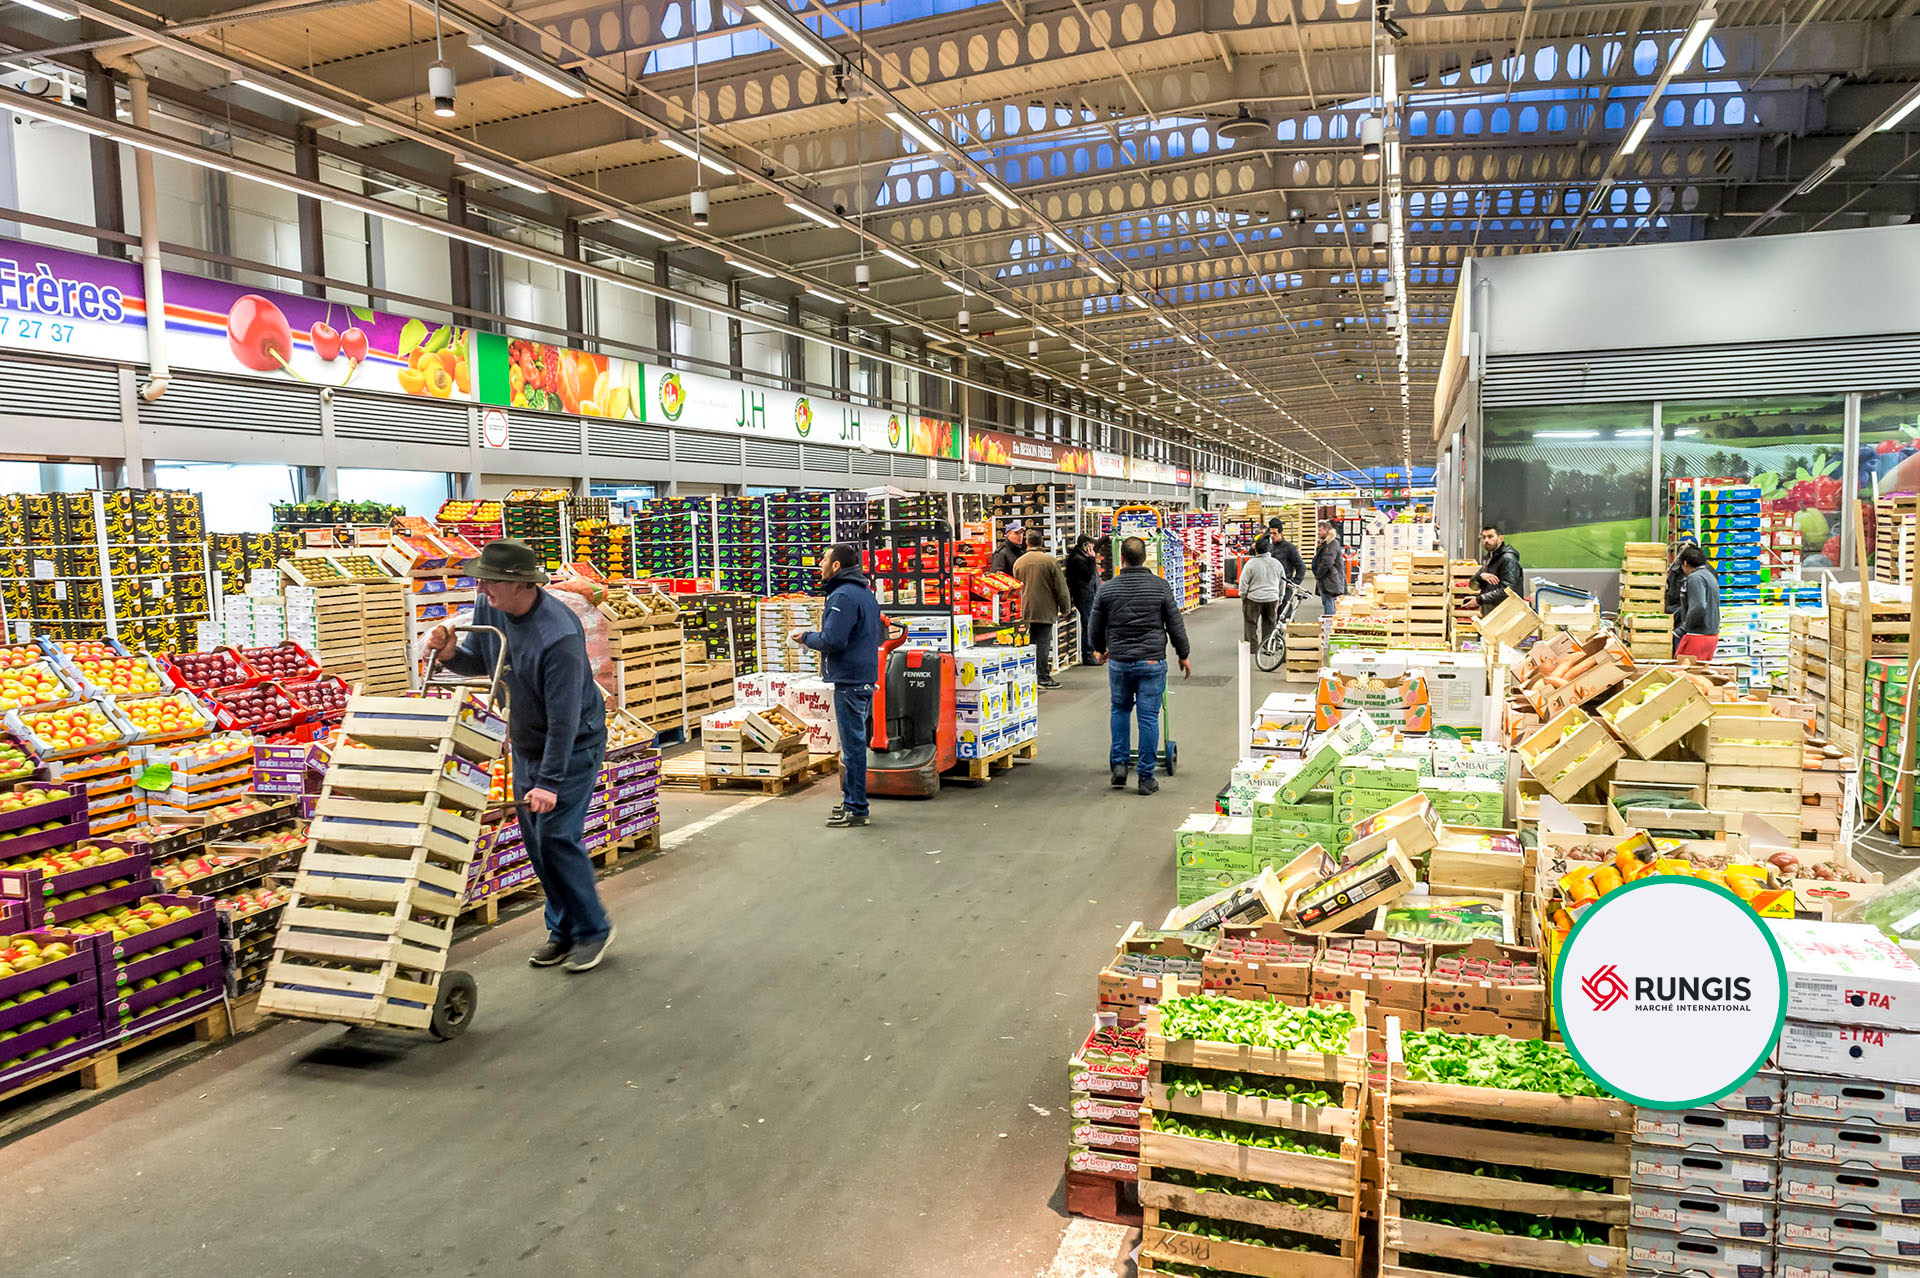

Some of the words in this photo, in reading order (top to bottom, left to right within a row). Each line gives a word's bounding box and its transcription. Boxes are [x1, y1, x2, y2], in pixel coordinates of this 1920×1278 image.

[0, 262, 123, 322] Frères
[19, 319, 42, 339] 27
[51, 323, 74, 343] 37
[799, 692, 820, 704] Hurdy
[959, 743, 974, 758] G
[1454, 762, 1489, 770] AMBAR
[1091, 1076, 1137, 1090] berrystars
[1091, 1104, 1137, 1117] berrystars
[1092, 1130, 1138, 1143] berrystars
[1090, 1158, 1136, 1170] berrystars
